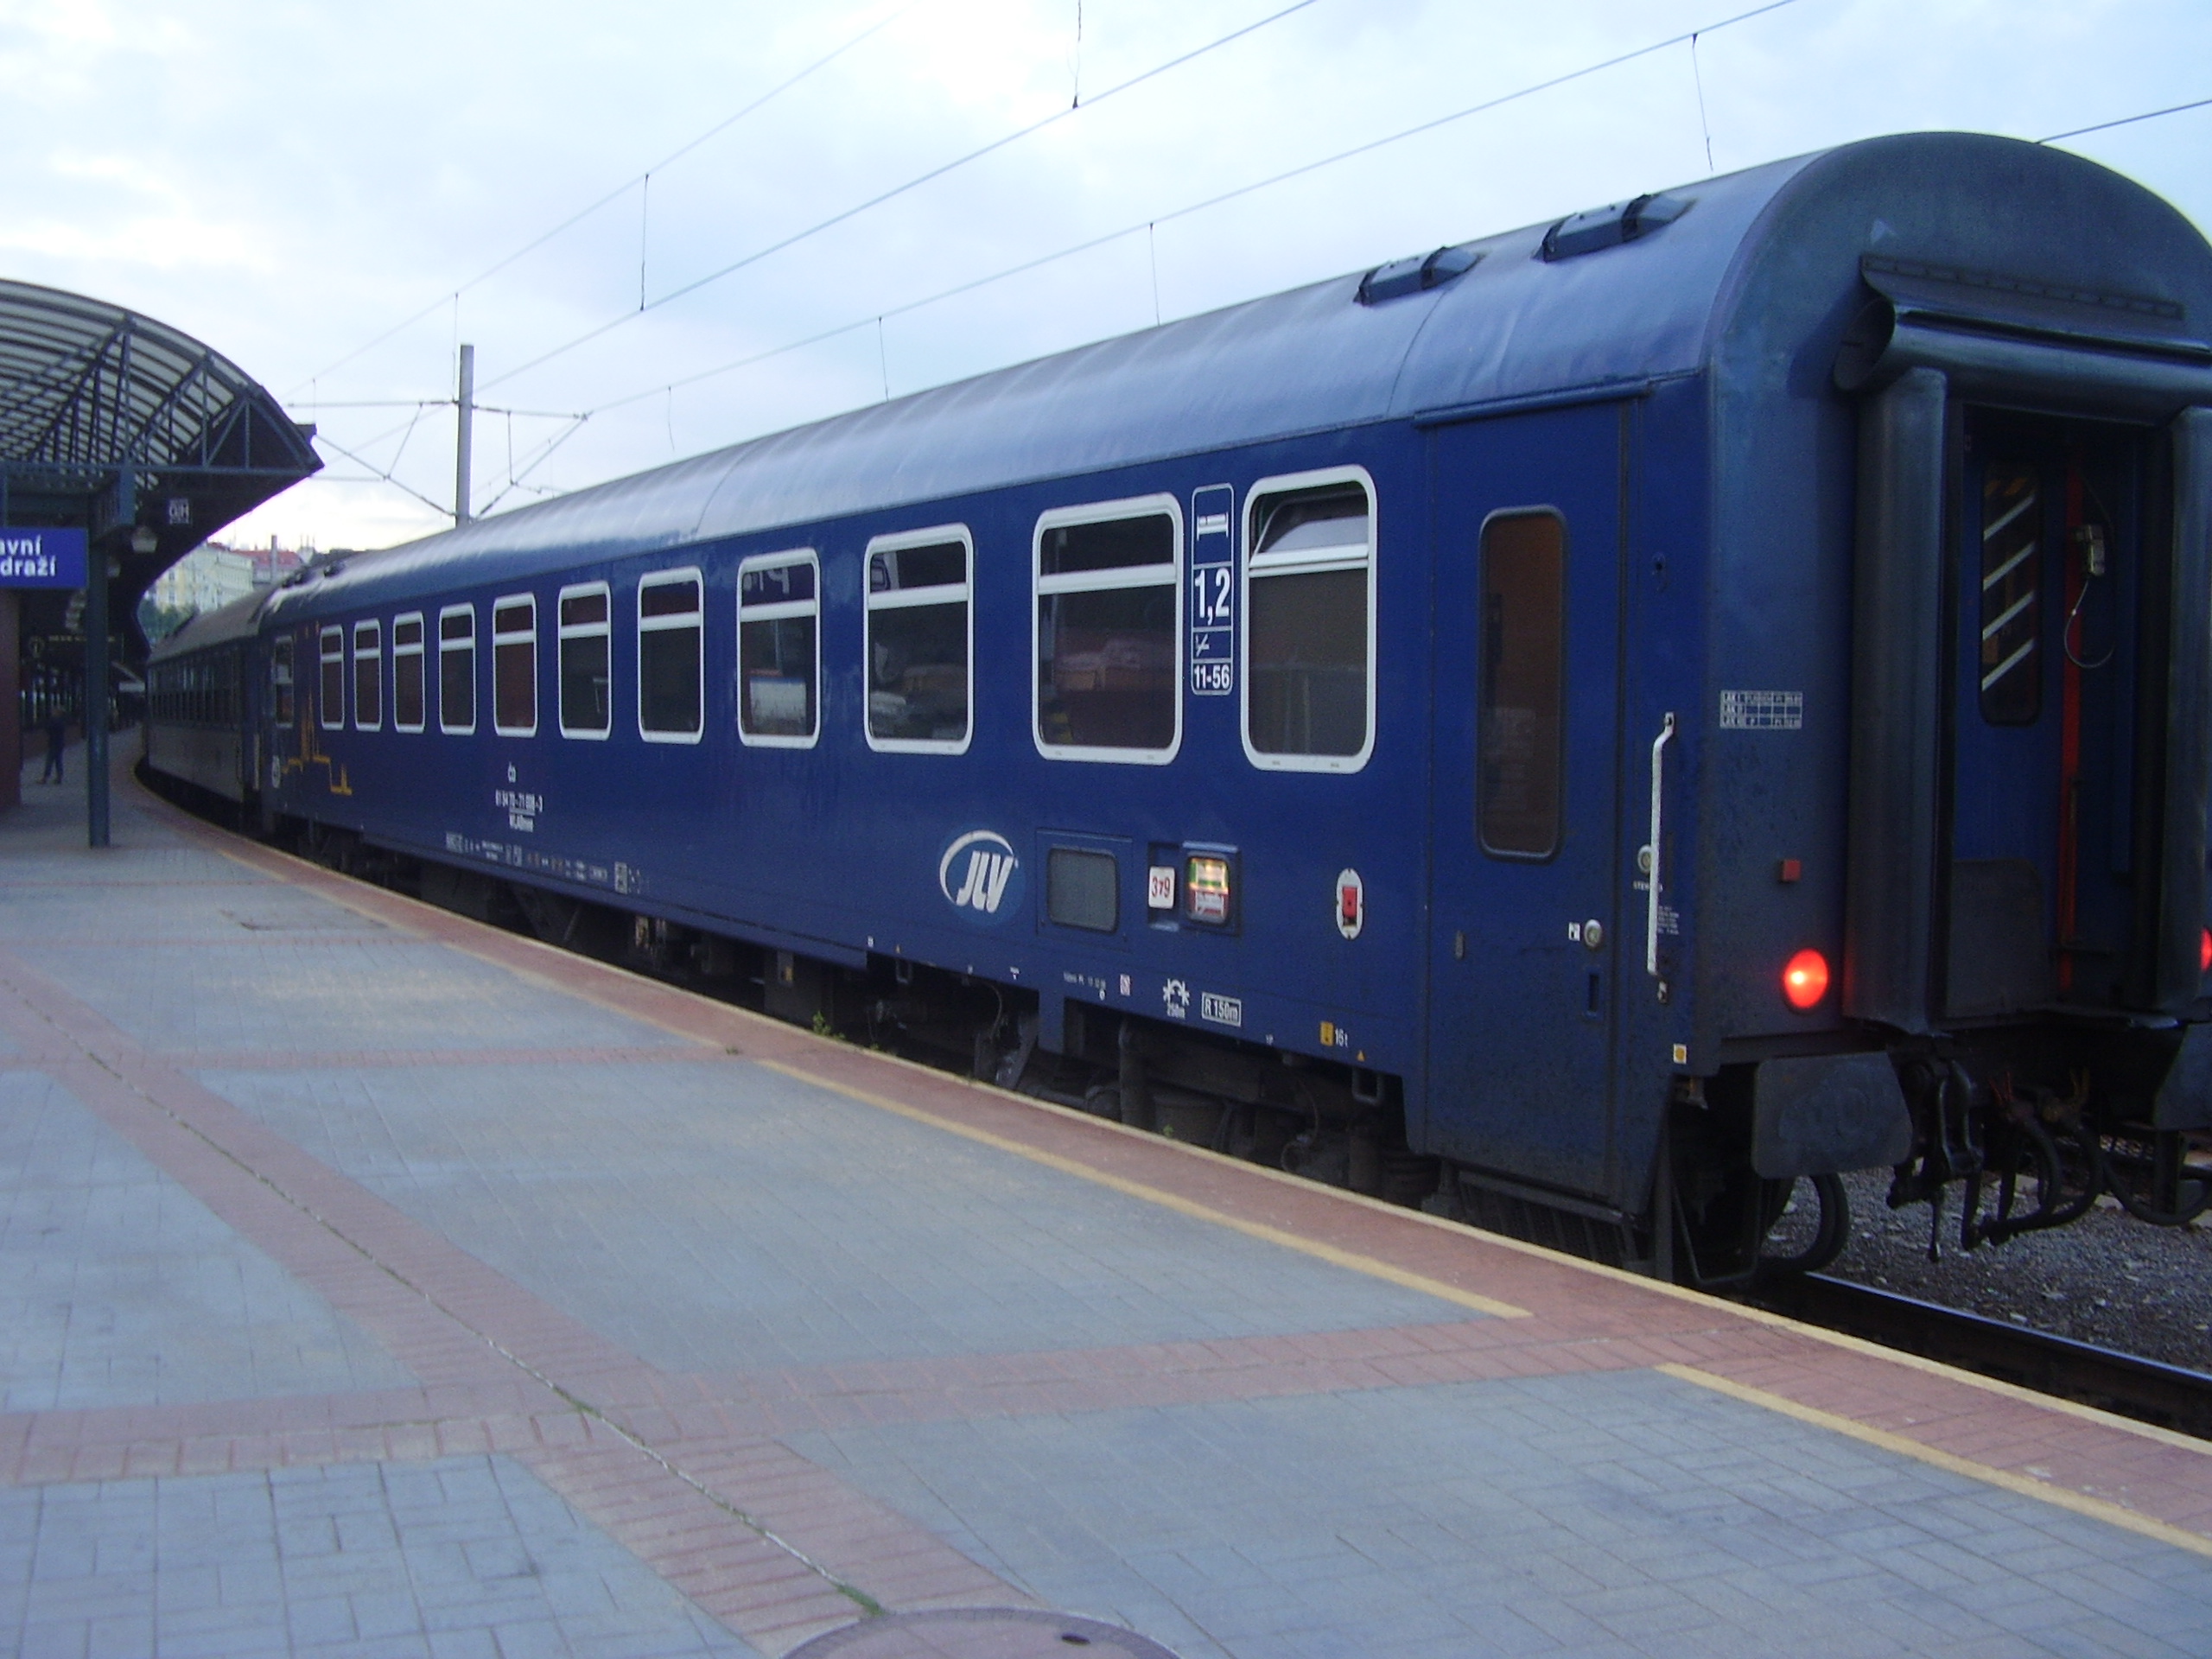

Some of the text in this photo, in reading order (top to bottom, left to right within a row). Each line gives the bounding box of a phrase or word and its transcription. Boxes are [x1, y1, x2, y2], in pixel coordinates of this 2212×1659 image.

[0, 555, 56, 576] draží
[1194, 568, 1231, 626] 1,2
[1193, 664, 1230, 690] 11-56
[956, 850, 1014, 913] JLV
